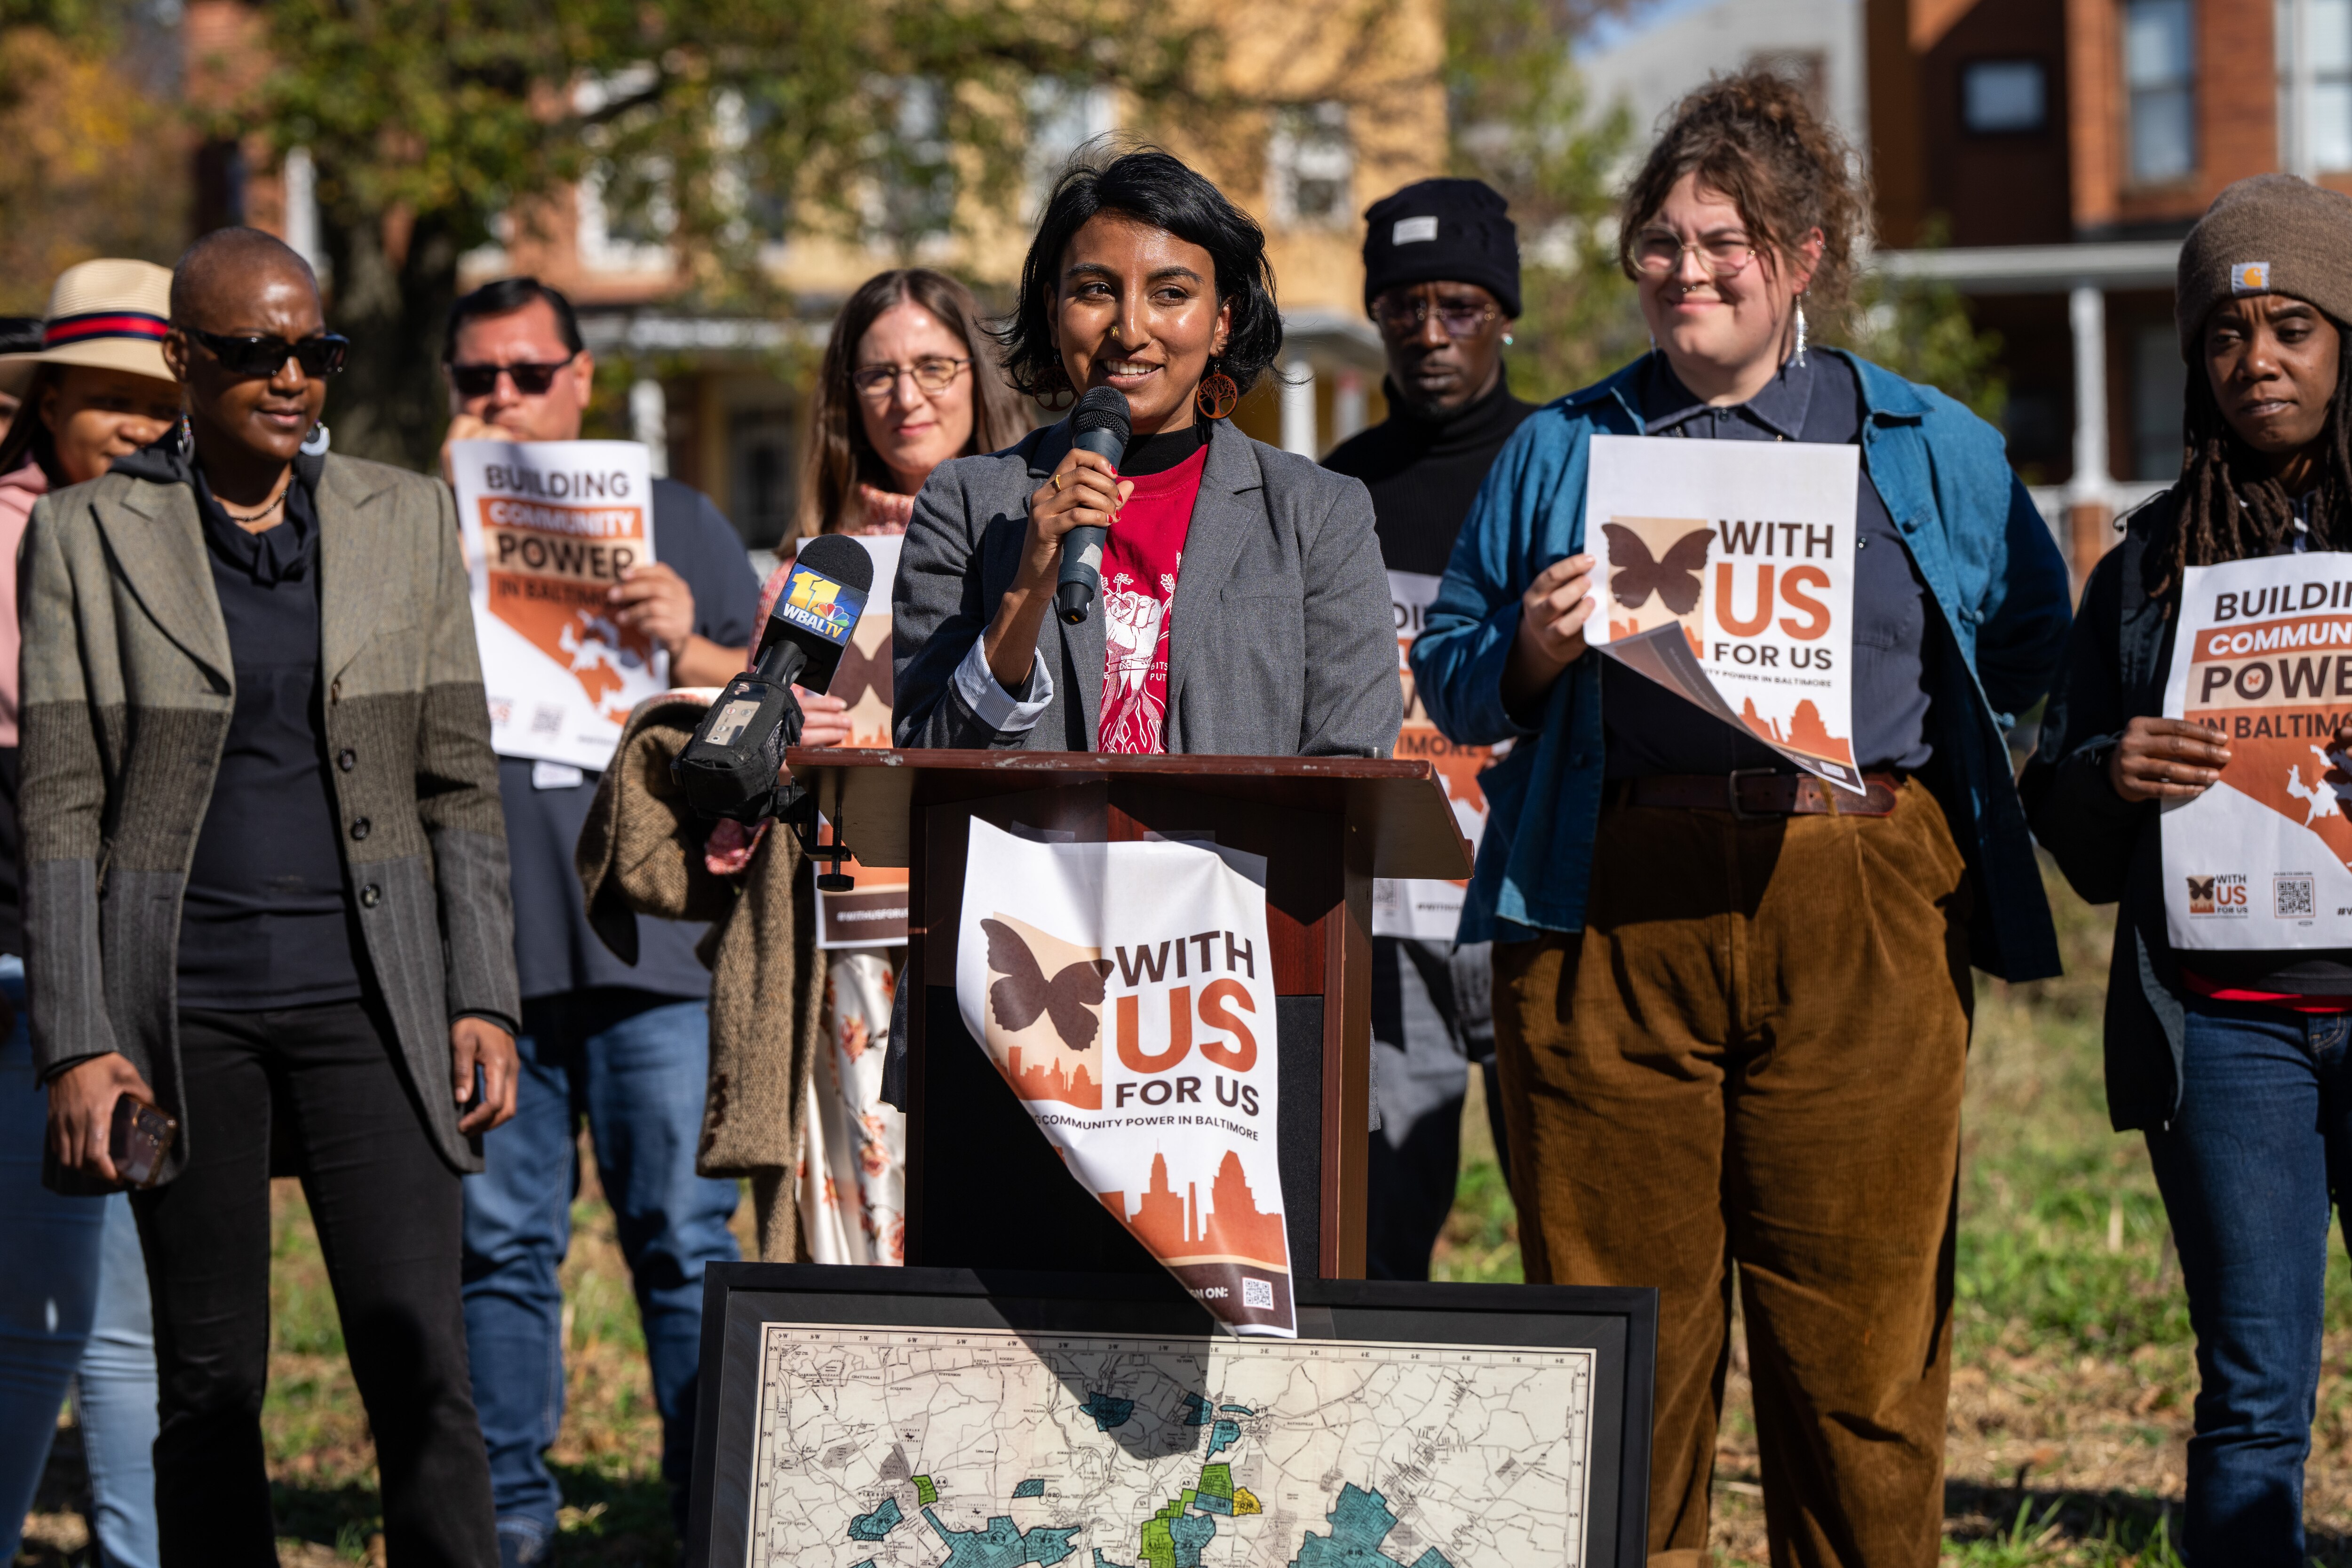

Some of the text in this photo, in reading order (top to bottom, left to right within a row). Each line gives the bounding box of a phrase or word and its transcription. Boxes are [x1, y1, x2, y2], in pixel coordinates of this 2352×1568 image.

[485, 464, 630, 498] BUILDING
[490, 502, 635, 537] COMMUNITY
[1718, 519, 1835, 558] WITH
[497, 533, 634, 582] POWER
[787, 571, 842, 612] 11
[1715, 562, 1832, 641] US
[2213, 580, 2352, 622] BUILDI
[1714, 641, 1832, 670] FOR US
[2208, 621, 2352, 656] COMMUN
[1150, 673, 1167, 682] PUT
[1722, 670, 1759, 682] POWER
[1774, 676, 1832, 687] BALTIMORE
[2200, 654, 2352, 704] POWE
[2235, 711, 2350, 739] BALTIM
[2216, 874, 2246, 883] WITH
[2216, 885, 2247, 905] US
[1115, 930, 1255, 987] WITH
[1116, 978, 1258, 1075] US
[1115, 1075, 1260, 1117] FOR US
[1041, 1114, 1123, 1130] COMMUNITY
[1126, 1115, 1175, 1127] POWER
[1178, 1115, 1192, 1125] IN
[1196, 1115, 1259, 1141] BALTIMORE
[1205, 1287, 1229, 1299] ON:
